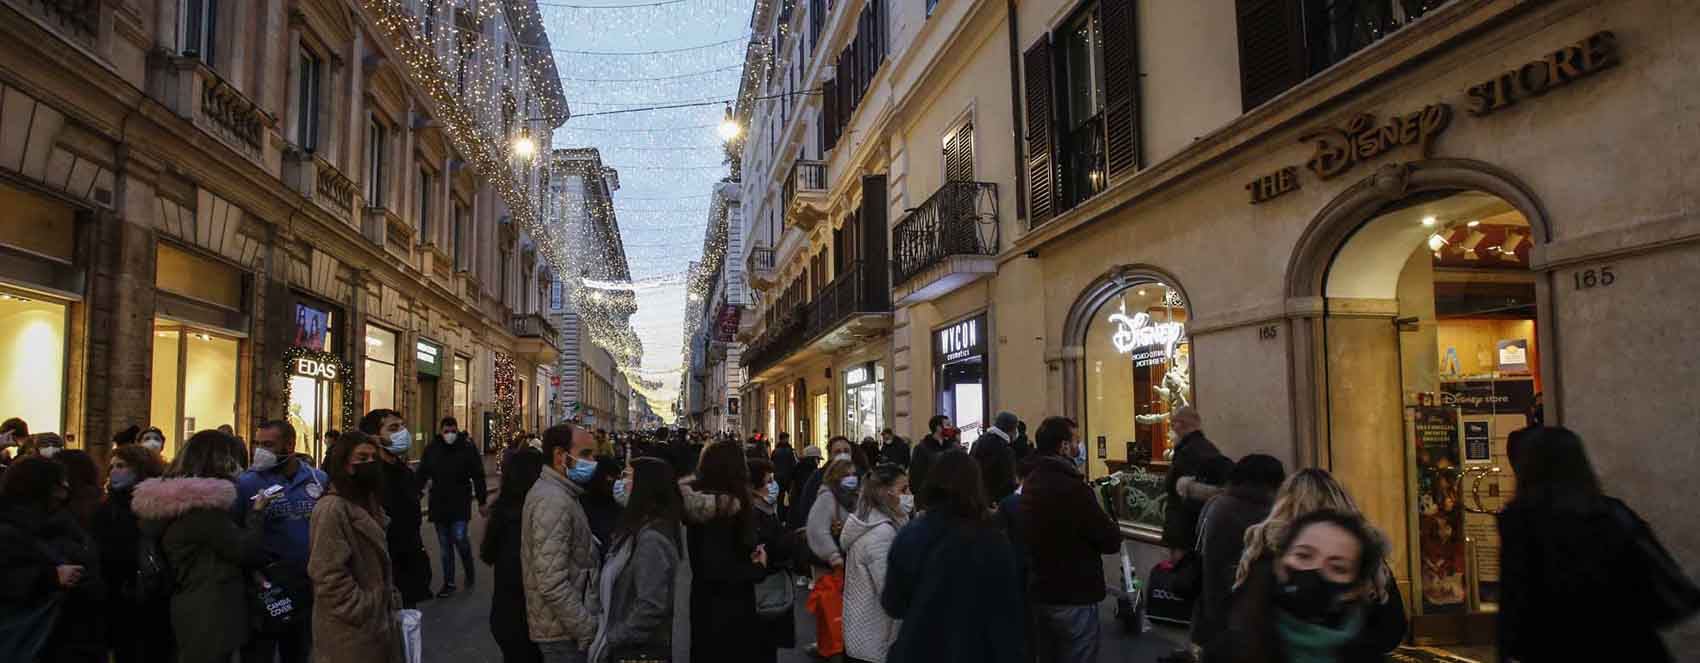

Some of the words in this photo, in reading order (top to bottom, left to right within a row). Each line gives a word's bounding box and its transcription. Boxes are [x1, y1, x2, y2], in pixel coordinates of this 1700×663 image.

[1247, 165, 1300, 204] THE
[1466, 30, 1619, 117] STORE
[1573, 266, 1616, 290] 165
[941, 319, 976, 355] WYCON
[947, 349, 970, 361] cosmetics
[298, 359, 336, 379] EDAS
